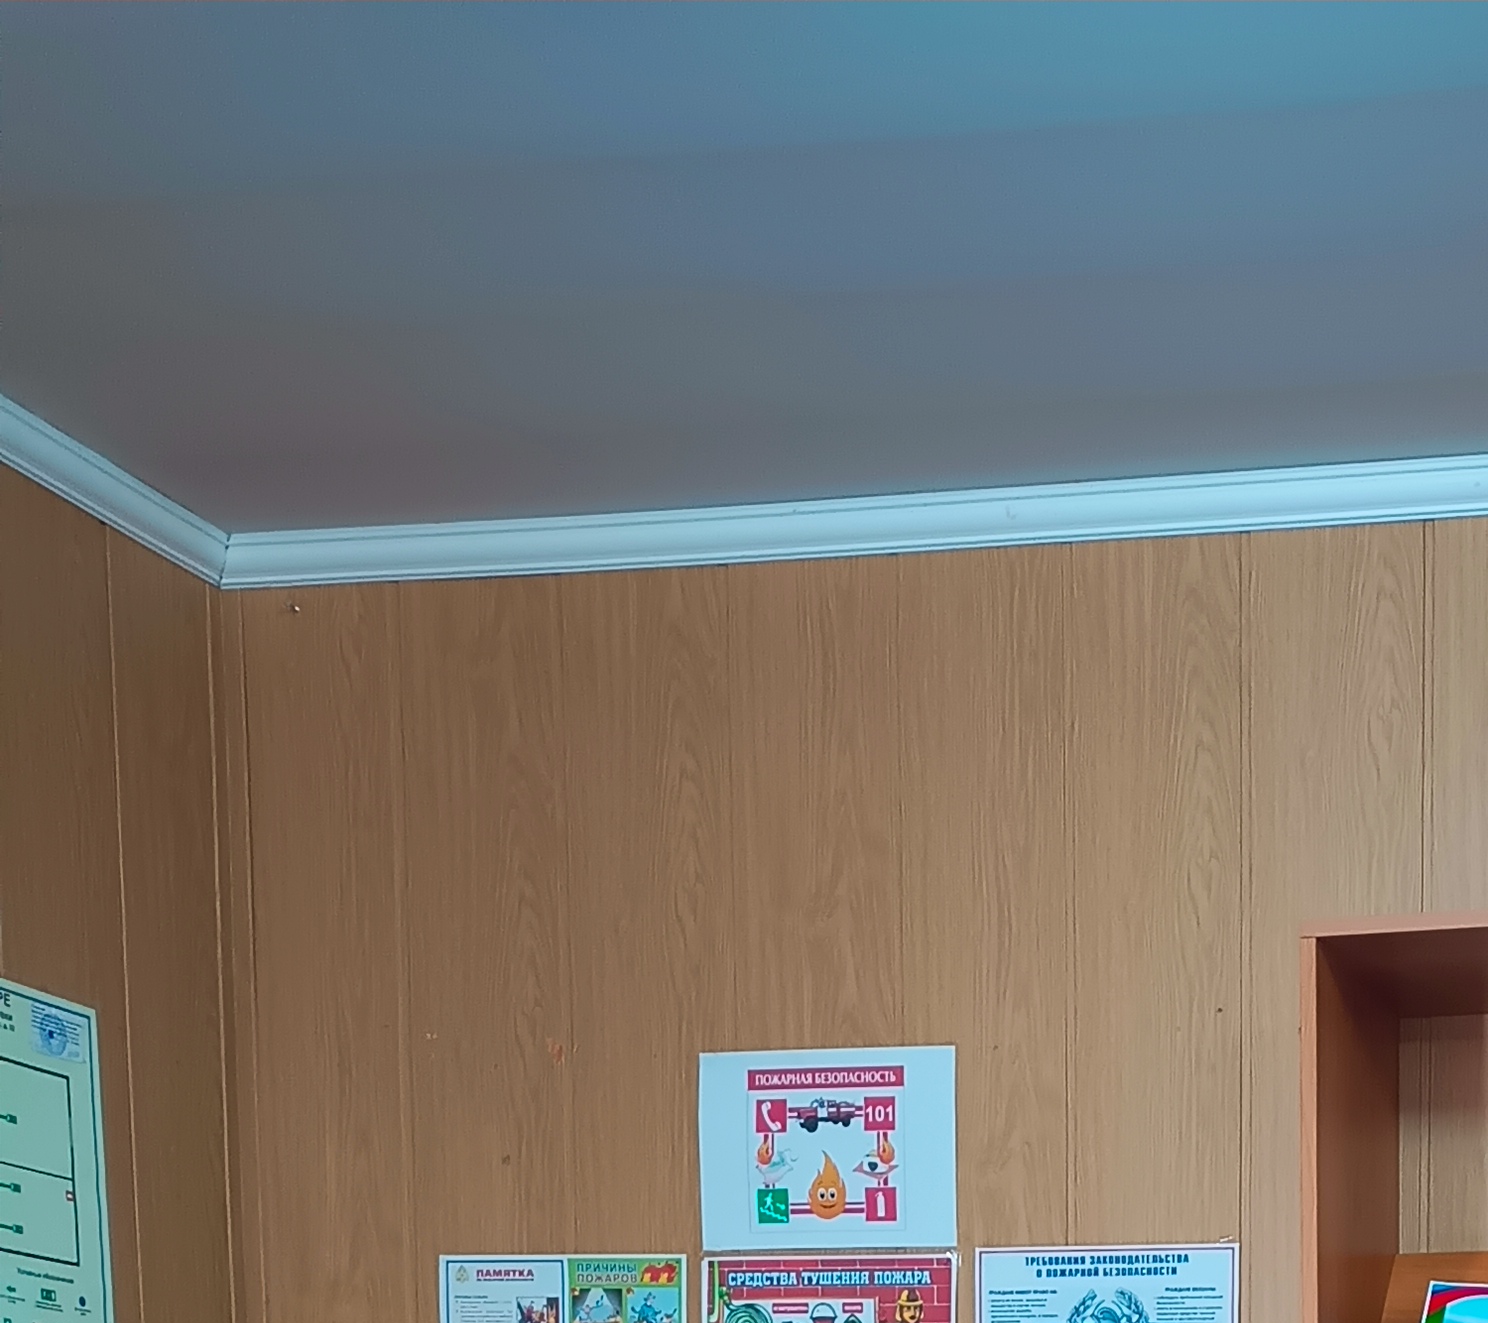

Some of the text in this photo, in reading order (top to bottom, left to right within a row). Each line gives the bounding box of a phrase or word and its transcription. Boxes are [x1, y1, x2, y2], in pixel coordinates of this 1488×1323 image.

[755, 1071, 896, 1085] ПОЖАРНАЯ БЕЗОПАСНОСТЬ
[866, 1105, 893, 1122] 101
[1025, 1254, 1189, 1266] ТРЕБОВАНИЯ ЗАКОНОДАТЕЛЬСТВА
[476, 1269, 534, 1278] ПАМЯТКА
[577, 1263, 636, 1273] ПРИЧИНЫ
[1036, 1267, 1177, 1278] О ПОЖАРНОЙ БЕЗОПАСНОСТИ
[577, 1273, 637, 1284] ПОЖАРОВ
[728, 1270, 931, 1286] СРЕДСТВА ТУШЕНИЯ ПОЖАРА
